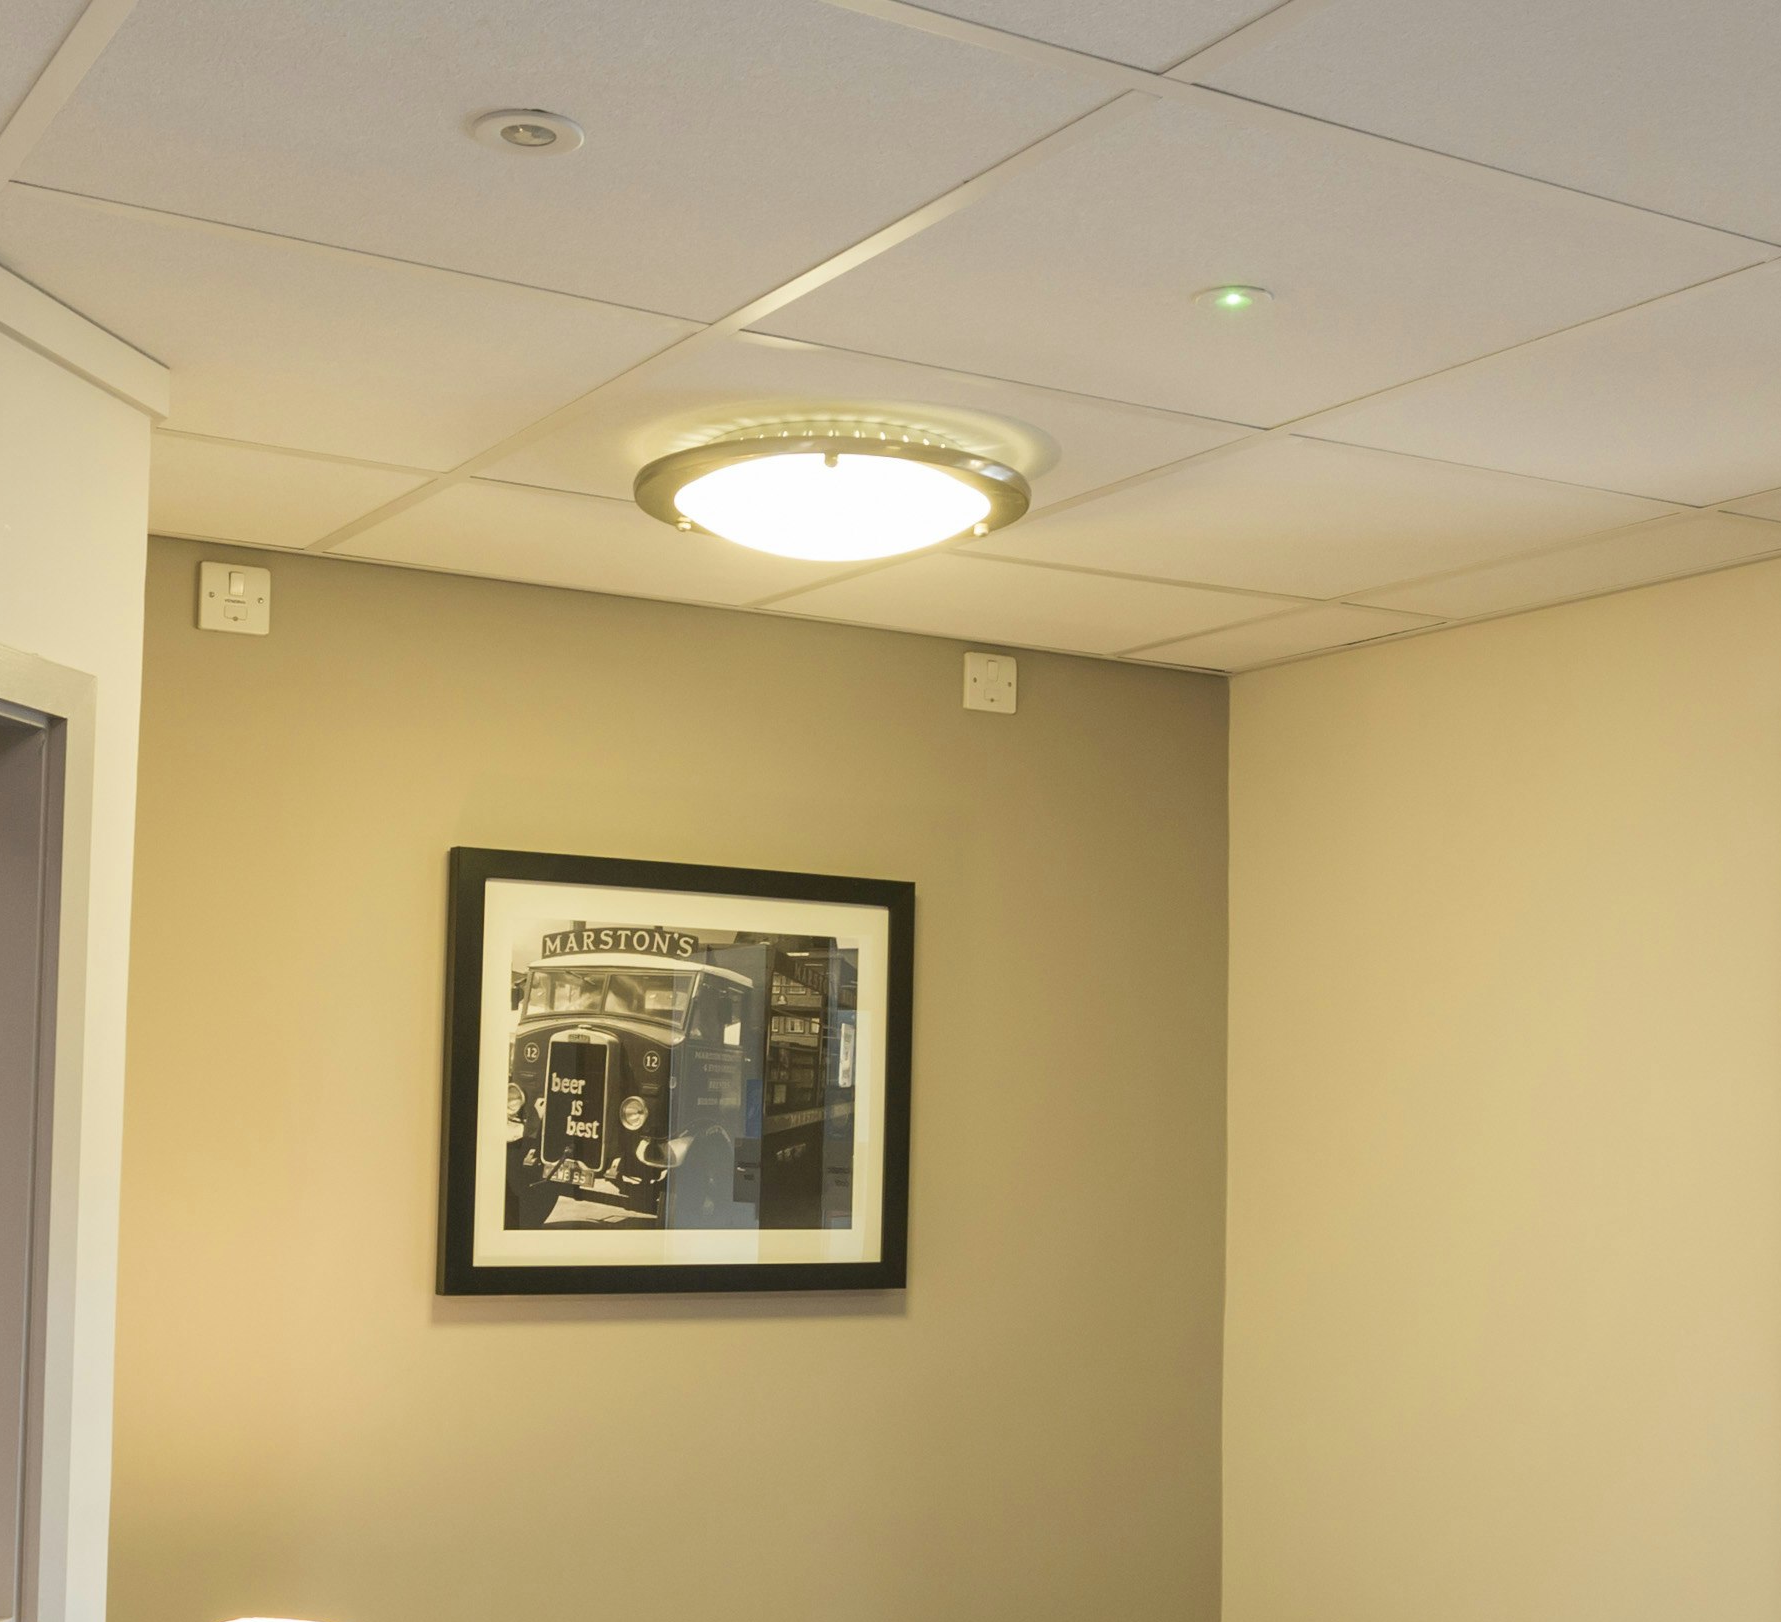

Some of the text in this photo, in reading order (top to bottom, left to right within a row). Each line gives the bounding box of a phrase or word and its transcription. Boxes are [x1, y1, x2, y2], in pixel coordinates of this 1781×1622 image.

[544, 930, 694, 957] MARSTON'S
[526, 1047, 538, 1059] 12
[646, 1055, 658, 1068] 12
[551, 1072, 586, 1094] beer
[566, 1116, 599, 1139] best
